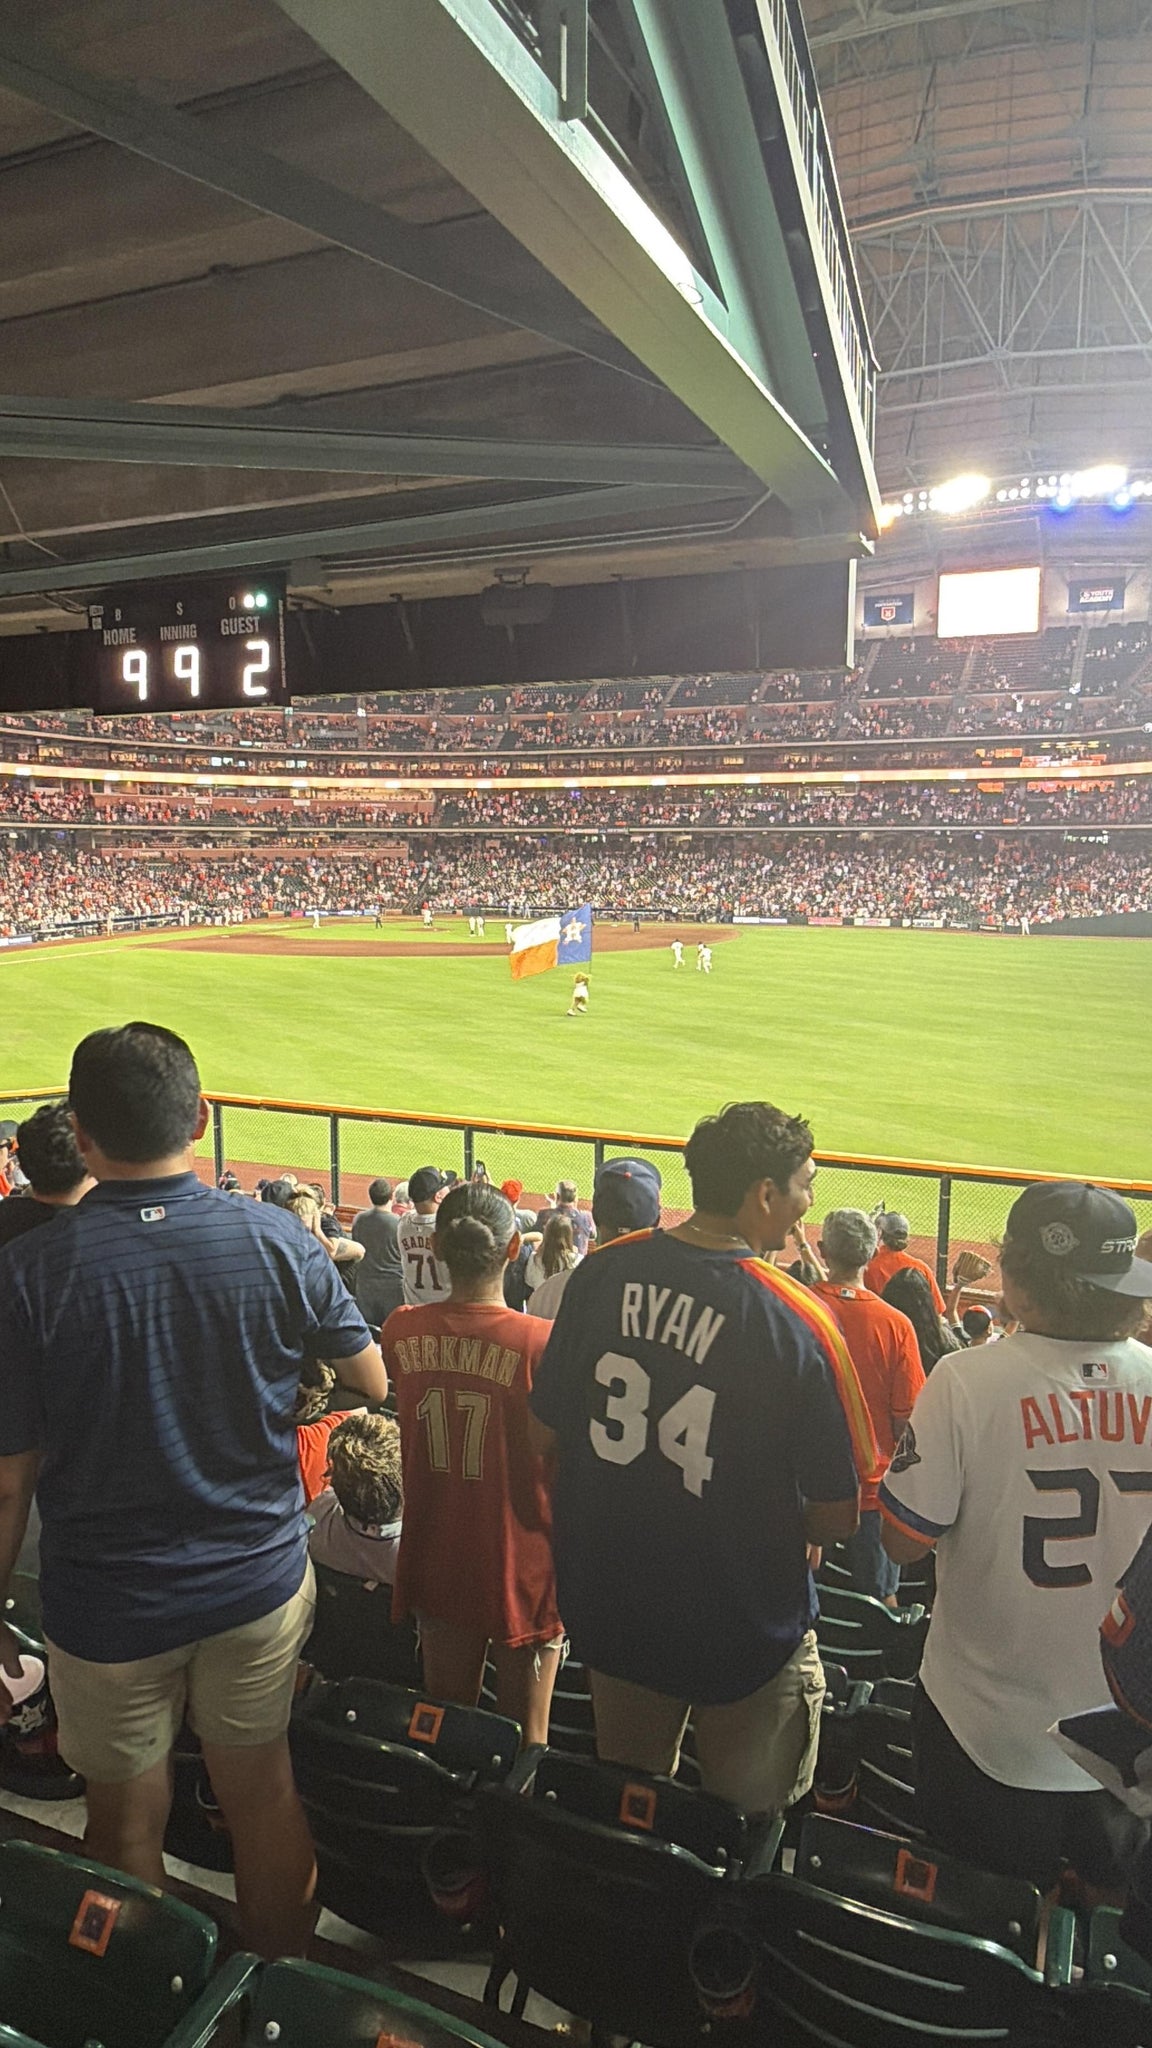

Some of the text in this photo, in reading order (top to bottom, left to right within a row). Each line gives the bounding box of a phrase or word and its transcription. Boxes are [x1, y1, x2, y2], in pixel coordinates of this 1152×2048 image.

[103, 615, 260, 646] HOME INNING GUEST
[115, 608, 122, 621] B
[176, 601, 183, 616] S
[122, 649, 148, 701] 9
[173, 645, 200, 697] 9
[242, 639, 270, 696] 2
[407, 1252, 443, 1291] 71
[621, 1282, 726, 1365] RYAN
[394, 1335, 521, 1388] BERKMAN
[416, 1387, 491, 1480] 17
[589, 1351, 717, 1499] 34
